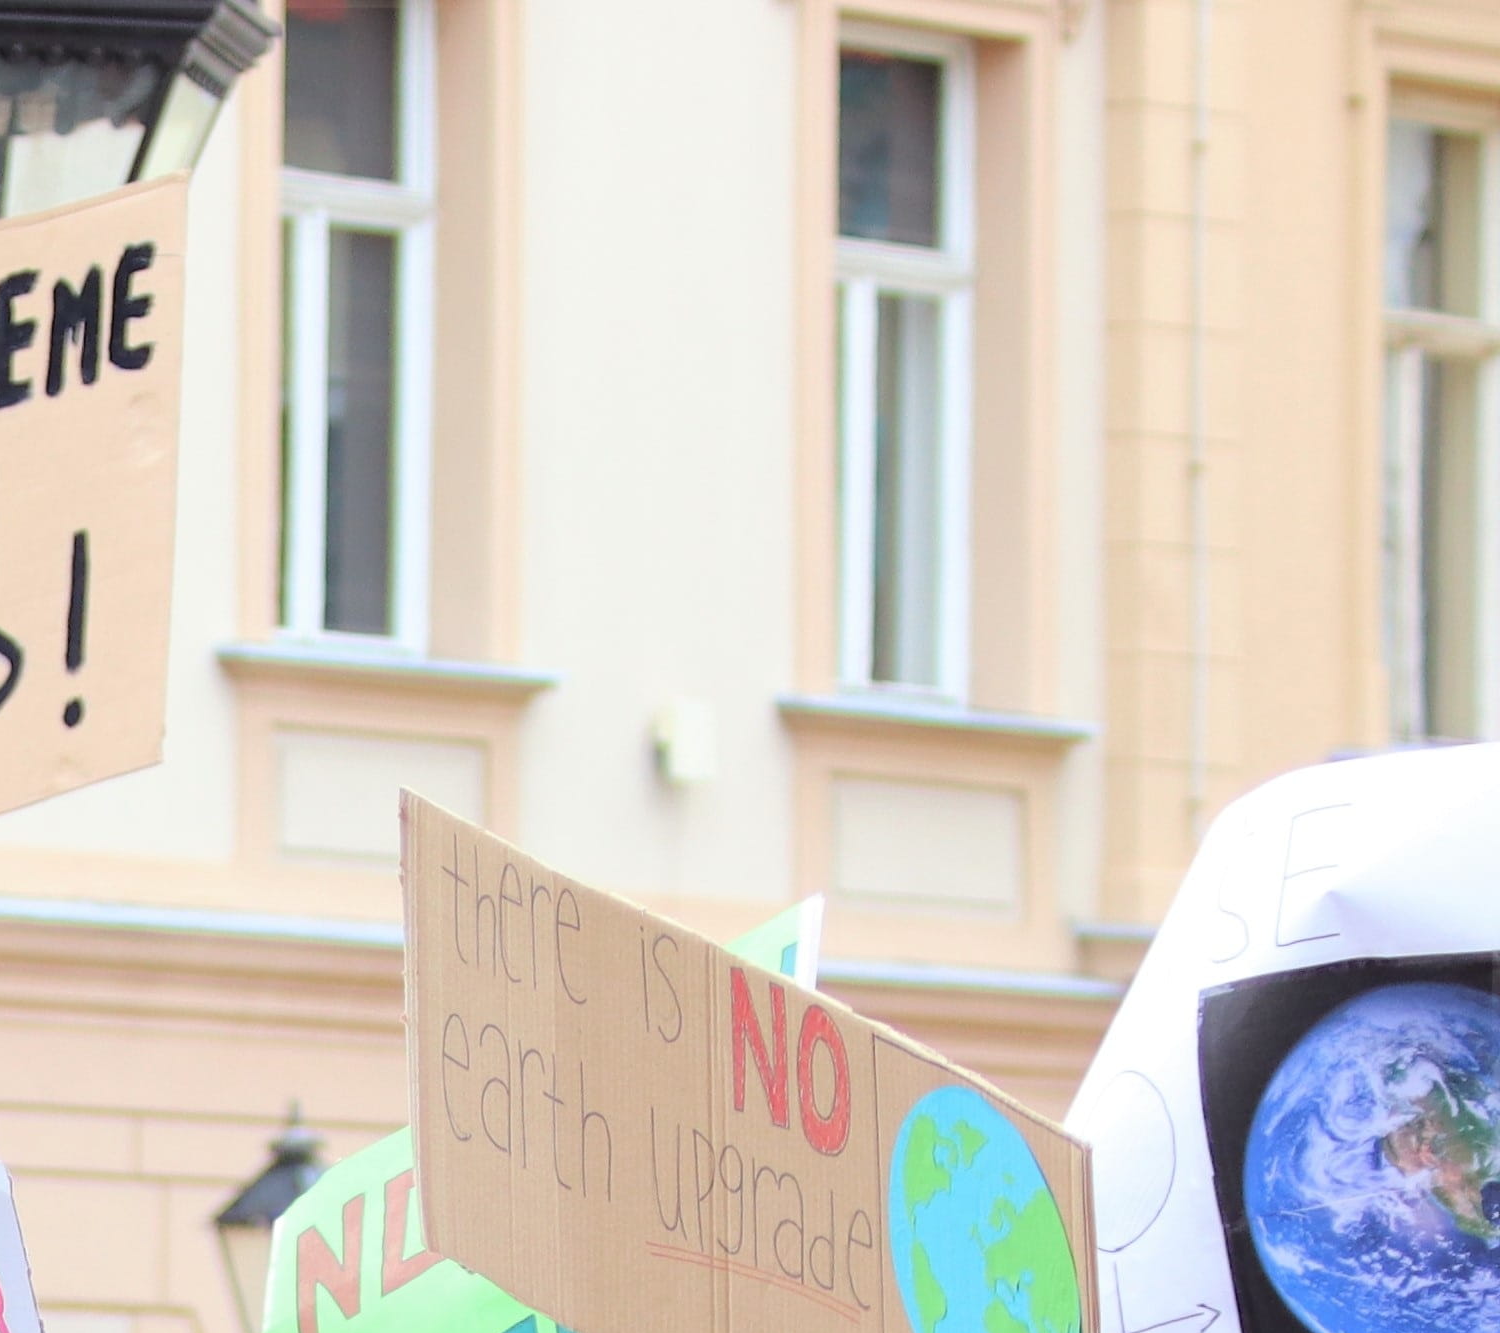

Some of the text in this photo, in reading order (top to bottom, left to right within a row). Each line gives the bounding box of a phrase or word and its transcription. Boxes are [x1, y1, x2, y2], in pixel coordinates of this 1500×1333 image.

[441, 832, 853, 1158] there is NO
[441, 1012, 876, 1314] earth upgrade
